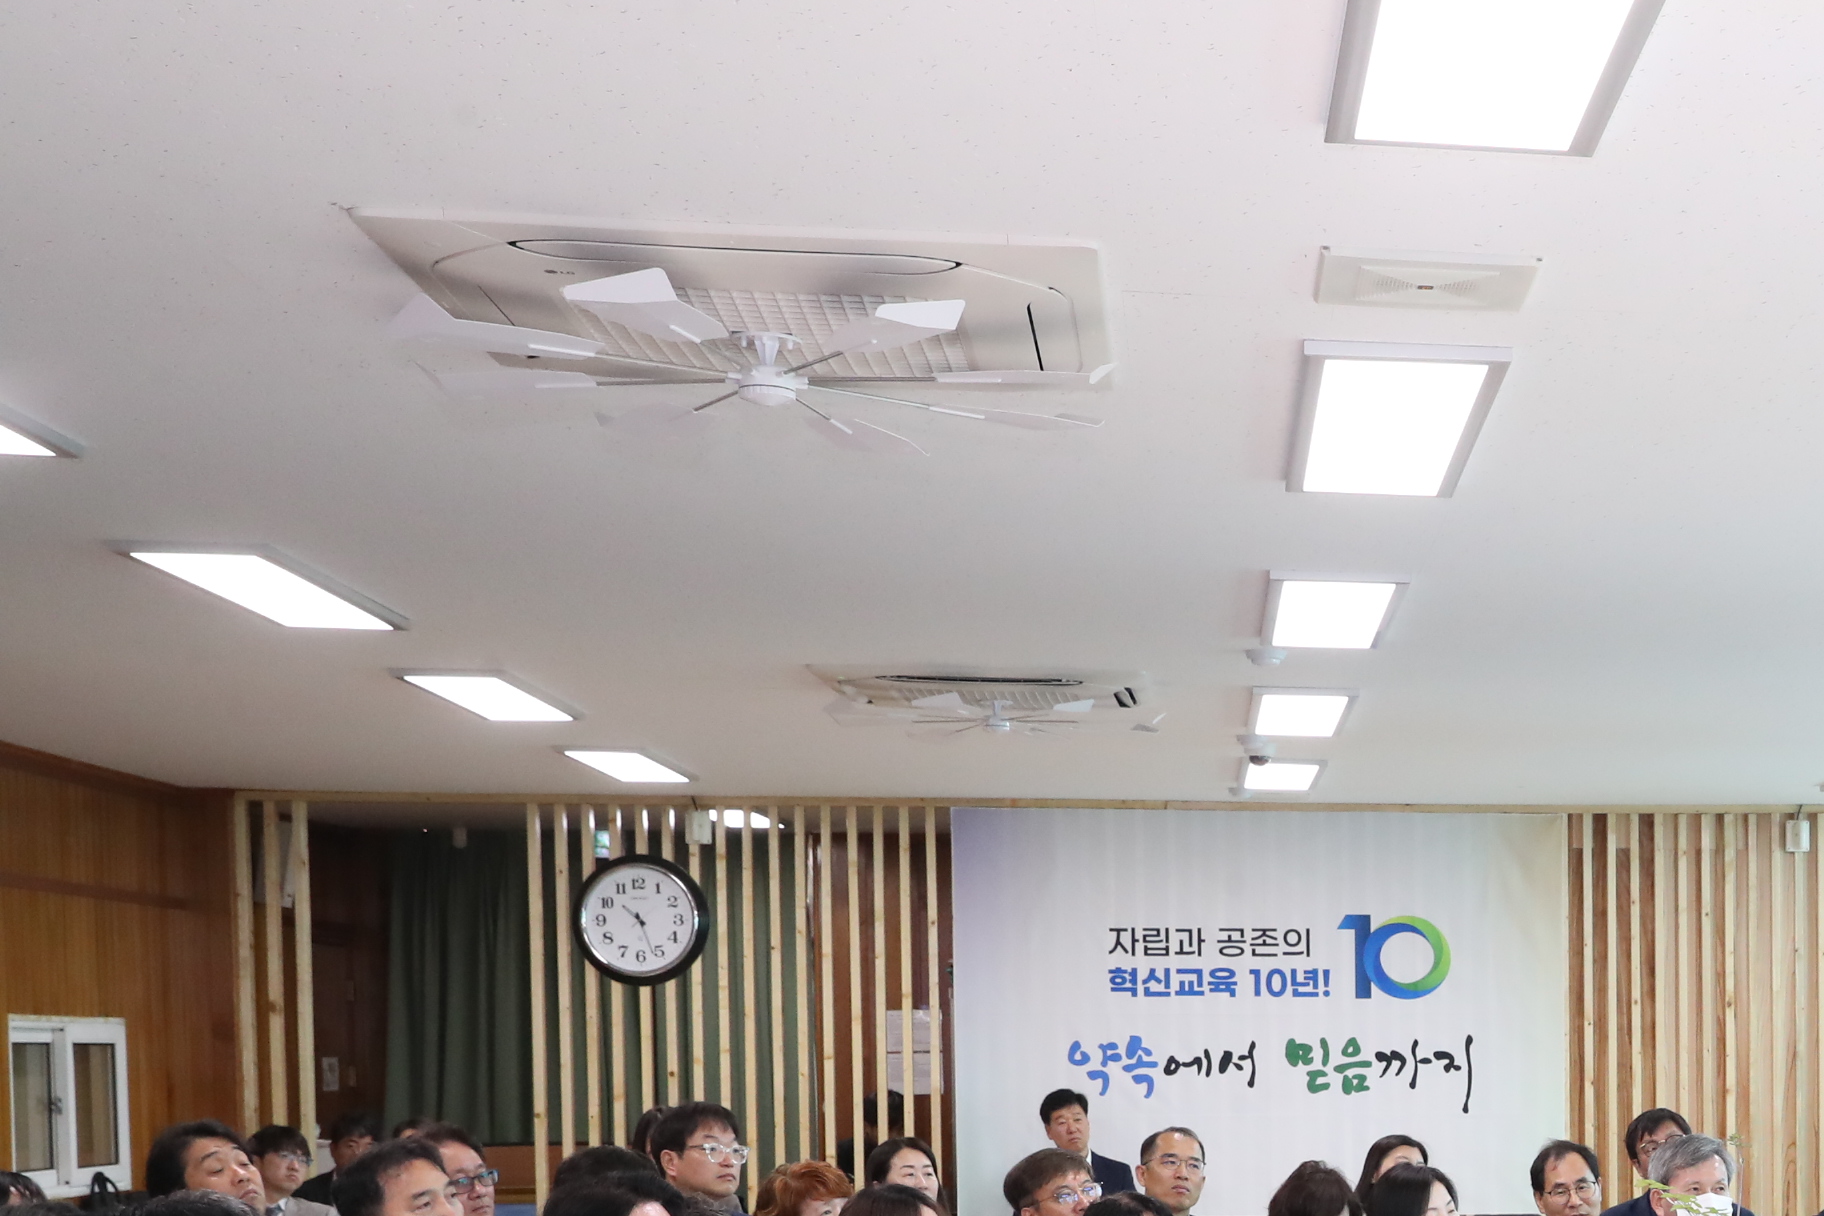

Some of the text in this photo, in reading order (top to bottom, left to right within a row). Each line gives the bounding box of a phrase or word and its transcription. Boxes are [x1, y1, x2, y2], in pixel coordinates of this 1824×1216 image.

[615, 882, 627, 895] 11
[631, 877, 646, 890] 12
[655, 882, 661, 894] 1
[601, 896, 614, 909] 10
[667, 895, 679, 908] 2
[595, 914, 607, 927] 9
[673, 914, 684, 926] 3
[602, 931, 614, 945] 8
[667, 930, 678, 944] 4
[1108, 927, 1311, 958] 자립과 공존의
[618, 945, 629, 958] 7
[636, 950, 646, 963] 6
[654, 945, 665, 958] 5
[1336, 914, 1451, 1000] 10
[1108, 967, 1332, 998] 혁신교육 10년!
[1068, 1034, 1473, 1113] 약속에서 믿음까지
